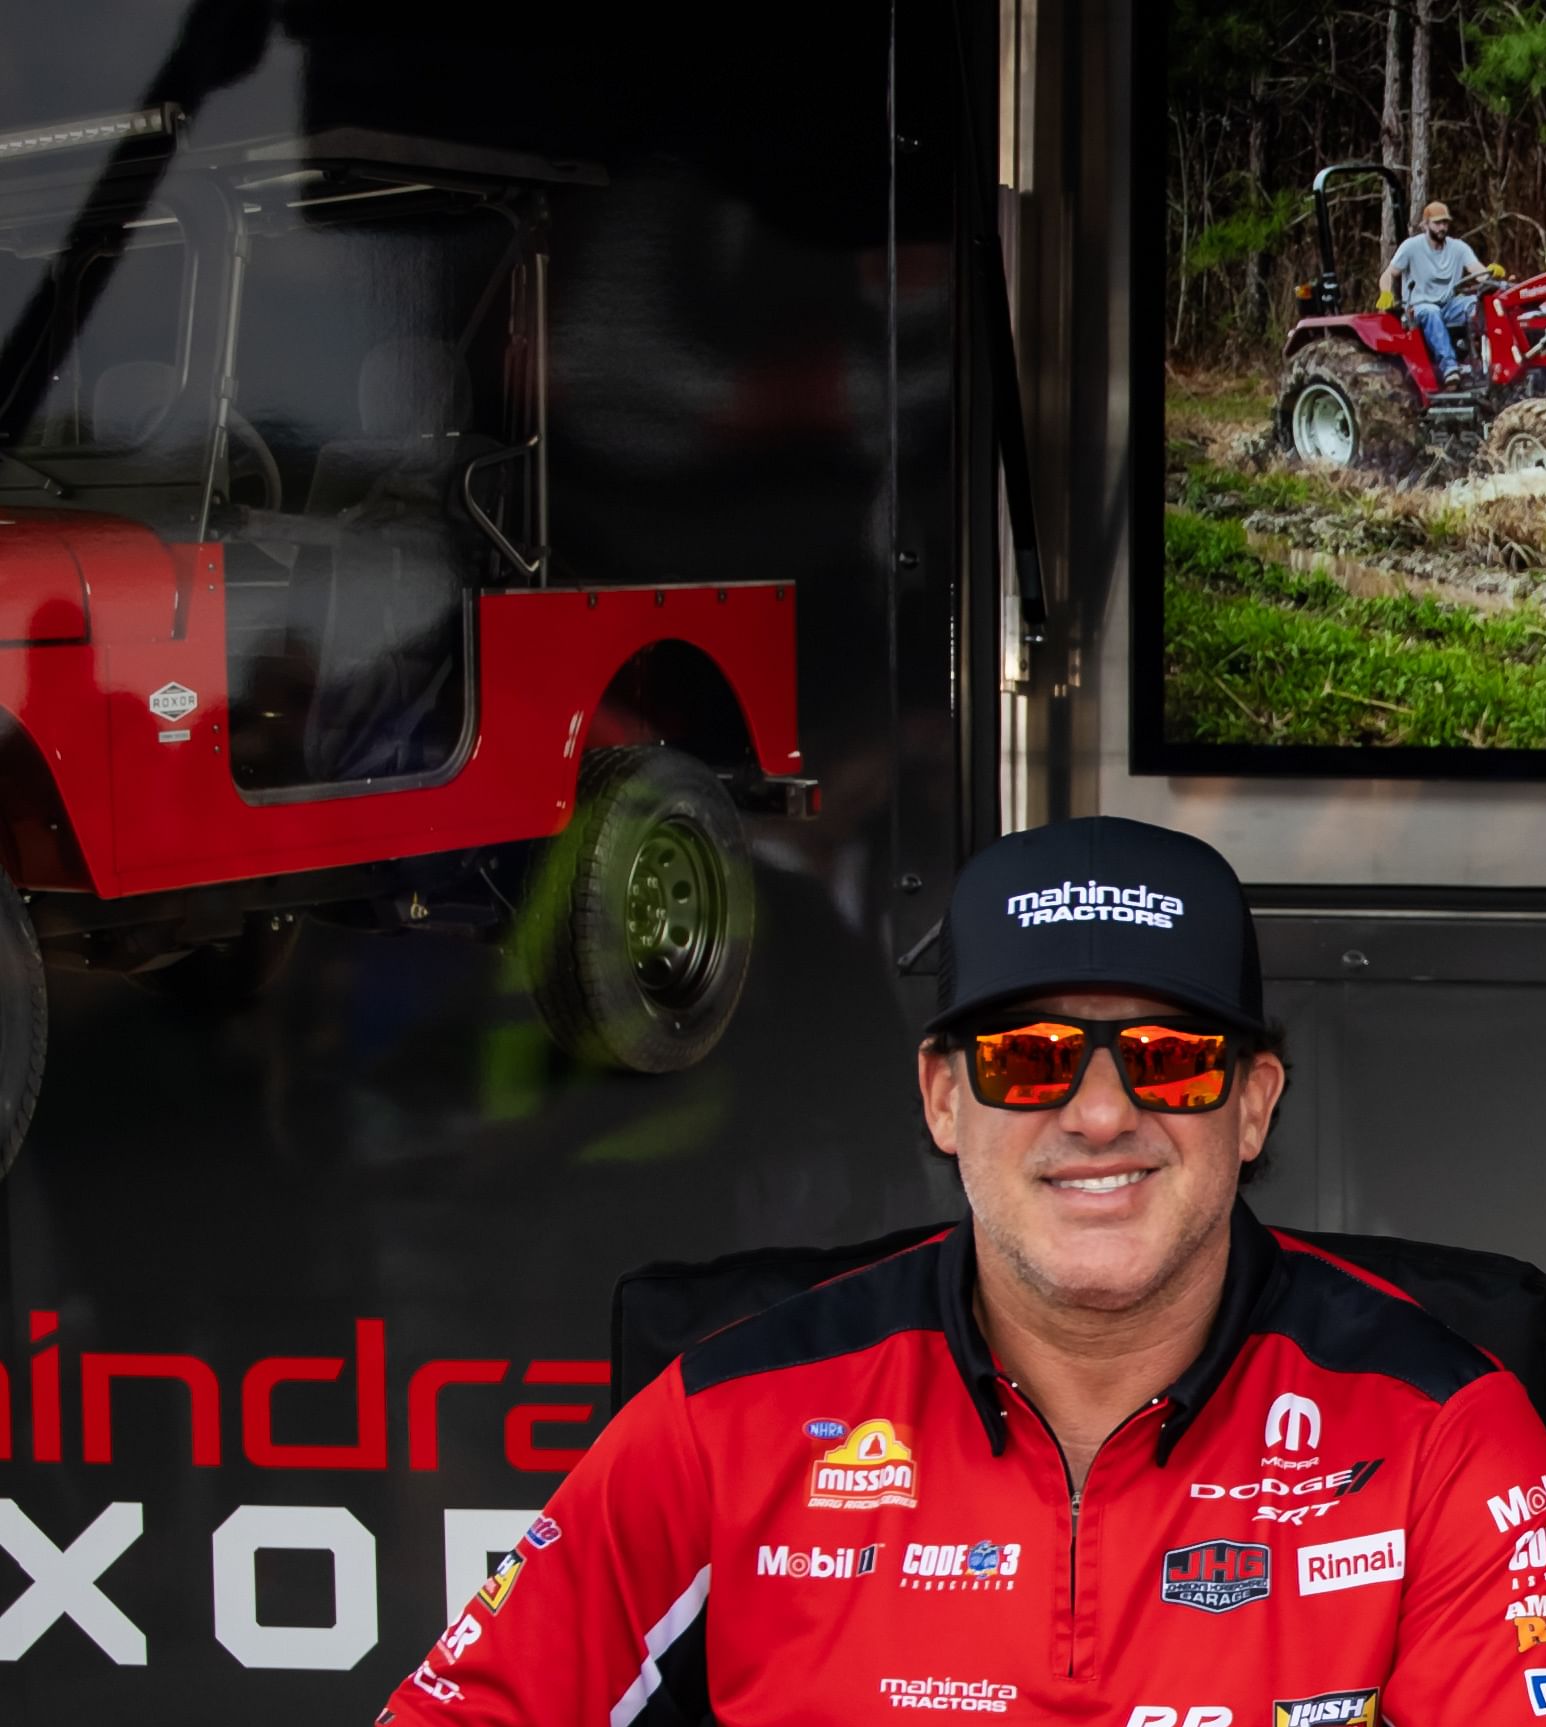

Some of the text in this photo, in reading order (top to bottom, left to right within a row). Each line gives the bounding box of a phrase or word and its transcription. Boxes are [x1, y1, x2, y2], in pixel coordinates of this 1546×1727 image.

[1007, 880, 1184, 915] mahindra
[1018, 904, 1173, 928] TRACTORS
[0, 1310, 611, 1472] indra
[1261, 1456, 1319, 1470] MOPAR
[1190, 1469, 1353, 1500] DODGE
[1251, 1500, 1340, 1526] SRT
[757, 1545, 854, 1578] Mobil
[903, 1543, 1021, 1576] CODE 3
[1168, 1547, 1266, 1581] JHG
[1180, 1590, 1251, 1606] GARAGE
[880, 1677, 1017, 1699] mahindra
[890, 1695, 1007, 1712] TRACTORS
